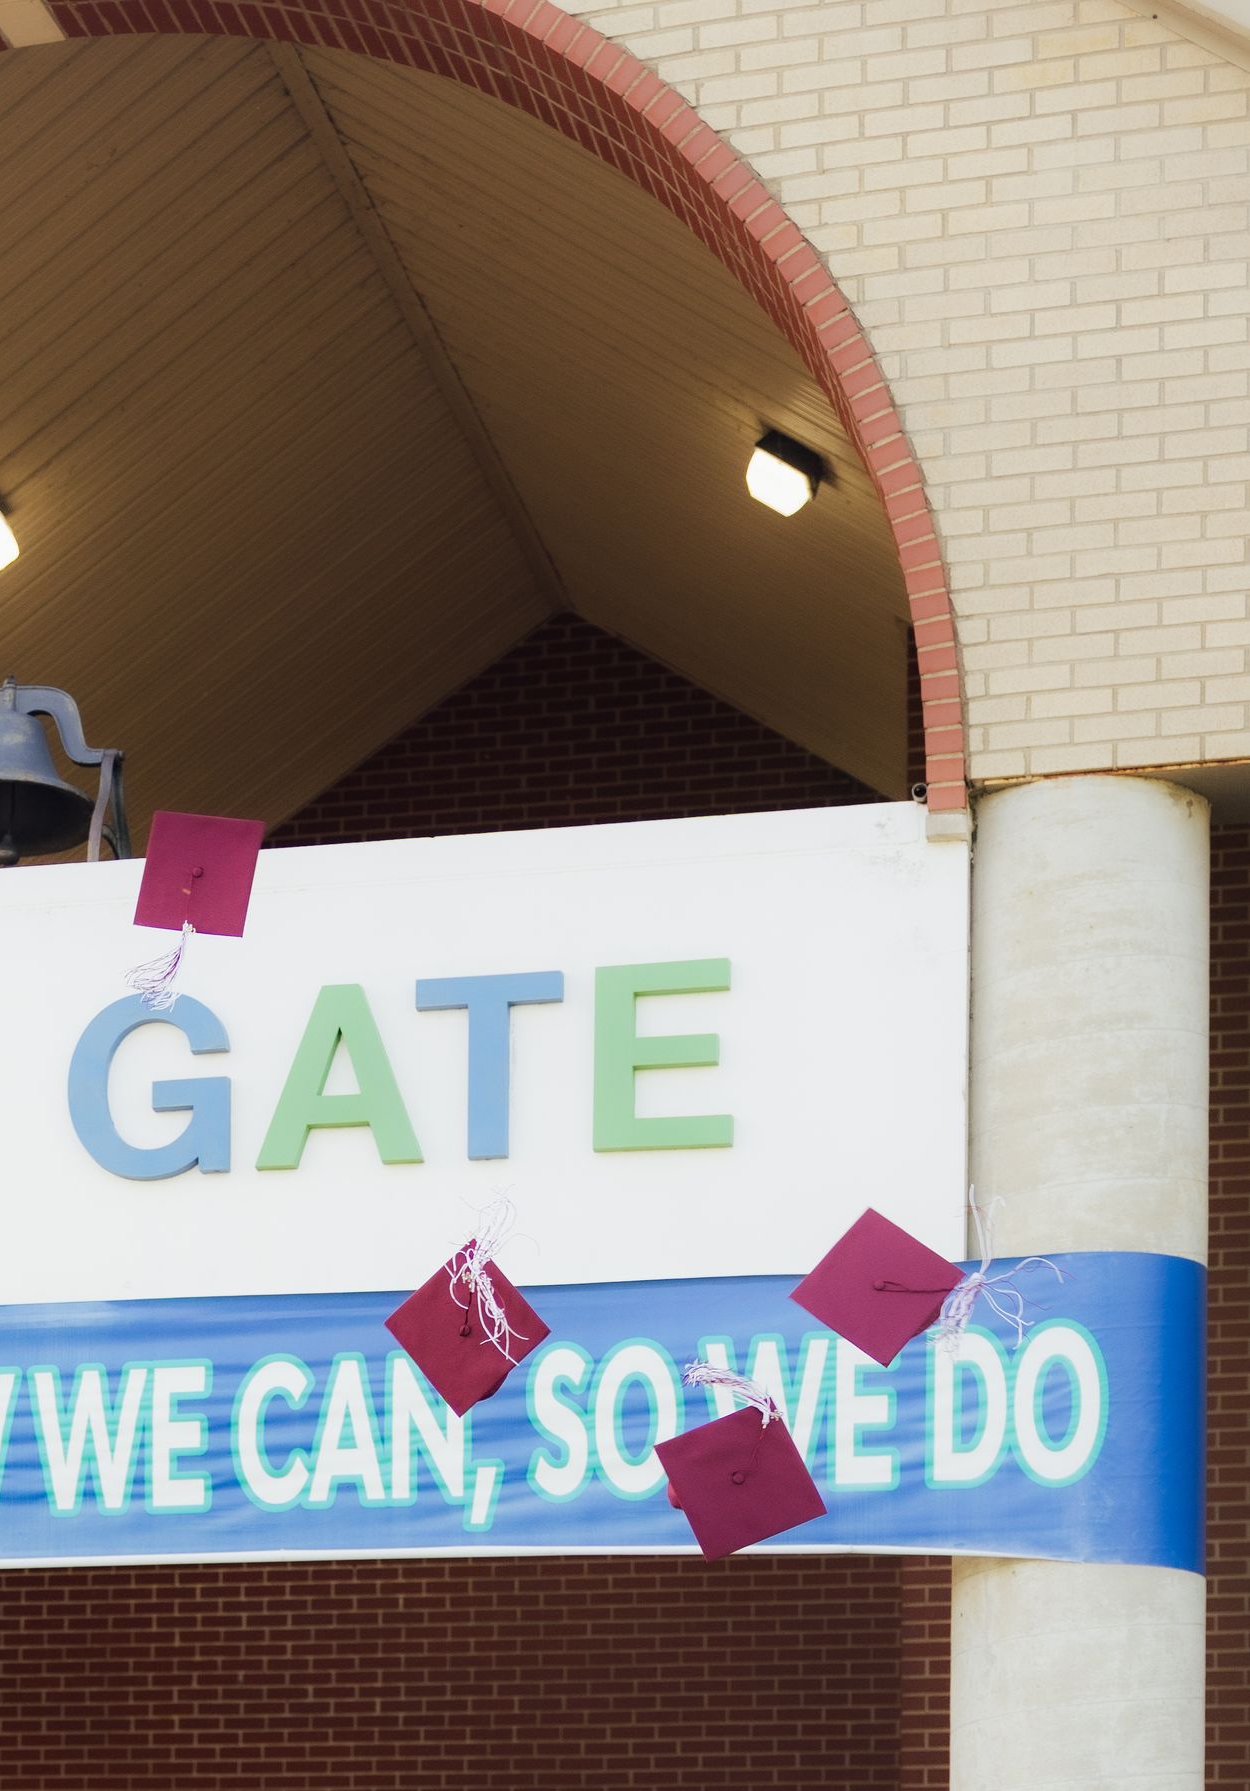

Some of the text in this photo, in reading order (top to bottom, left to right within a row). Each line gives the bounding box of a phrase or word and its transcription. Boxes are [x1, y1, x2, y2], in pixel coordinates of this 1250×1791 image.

[67, 956, 734, 1181] GATE
[30, 1354, 211, 1518] WE
[236, 1349, 504, 1530] CAN,
[528, 1338, 683, 1502] SO
[697, 1333, 899, 1491] WE
[926, 1318, 1108, 1489] DO
